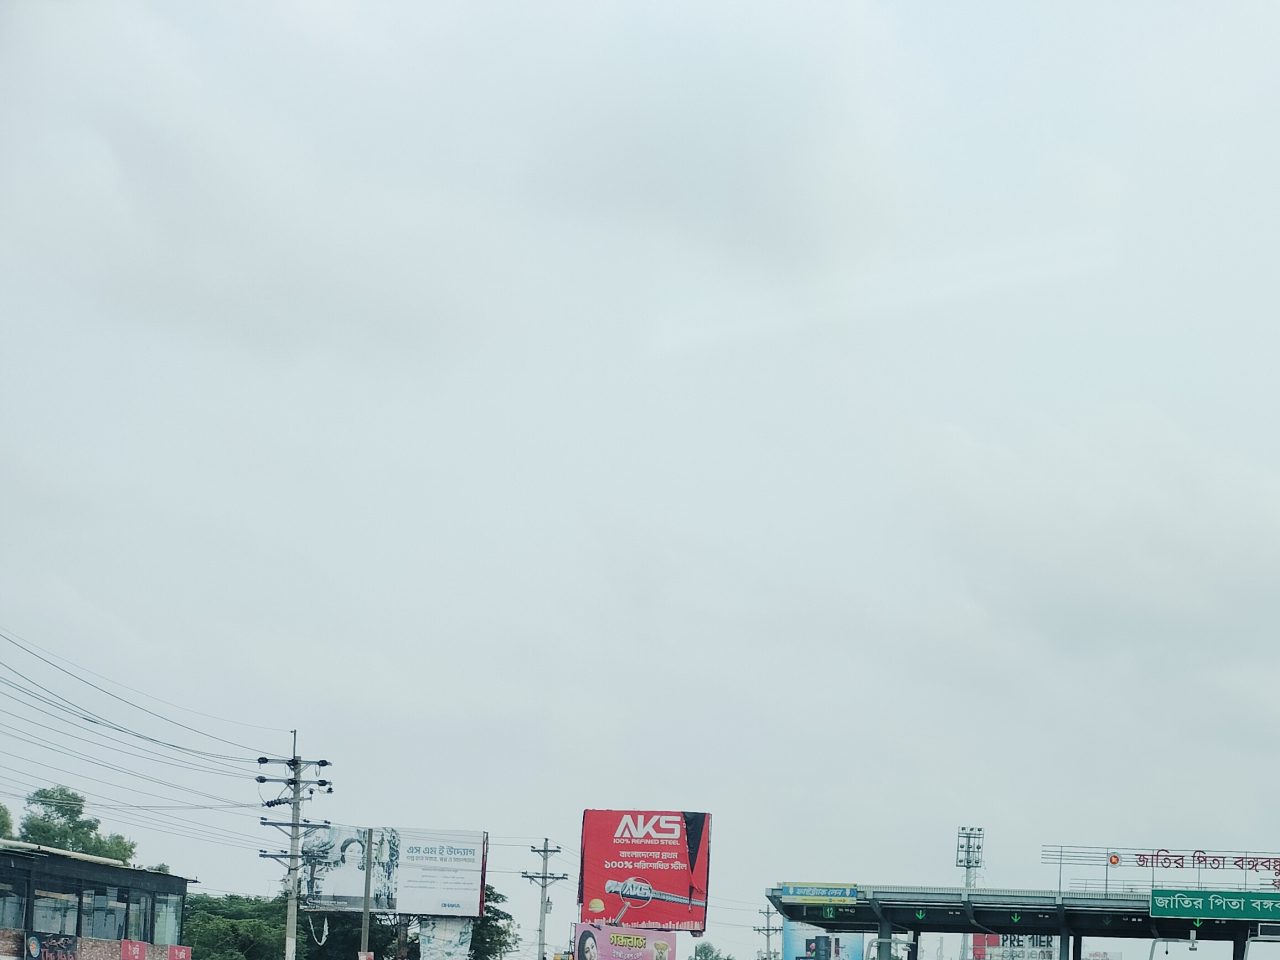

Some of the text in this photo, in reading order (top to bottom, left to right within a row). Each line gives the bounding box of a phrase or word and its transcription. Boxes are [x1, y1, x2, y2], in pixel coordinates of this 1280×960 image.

[614, 814, 681, 839] AKS
[619, 850, 678, 859] বাংলাদেশের প্রথম
[1135, 849, 1185, 868] জাতির
[1192, 850, 1226, 869] পিতা
[604, 860, 632, 869] ১০০%
[622, 883, 650, 897] AKS
[1153, 893, 1202, 910] জাতির
[1210, 894, 1245, 911] পিতা
[826, 907, 834, 918] 12
